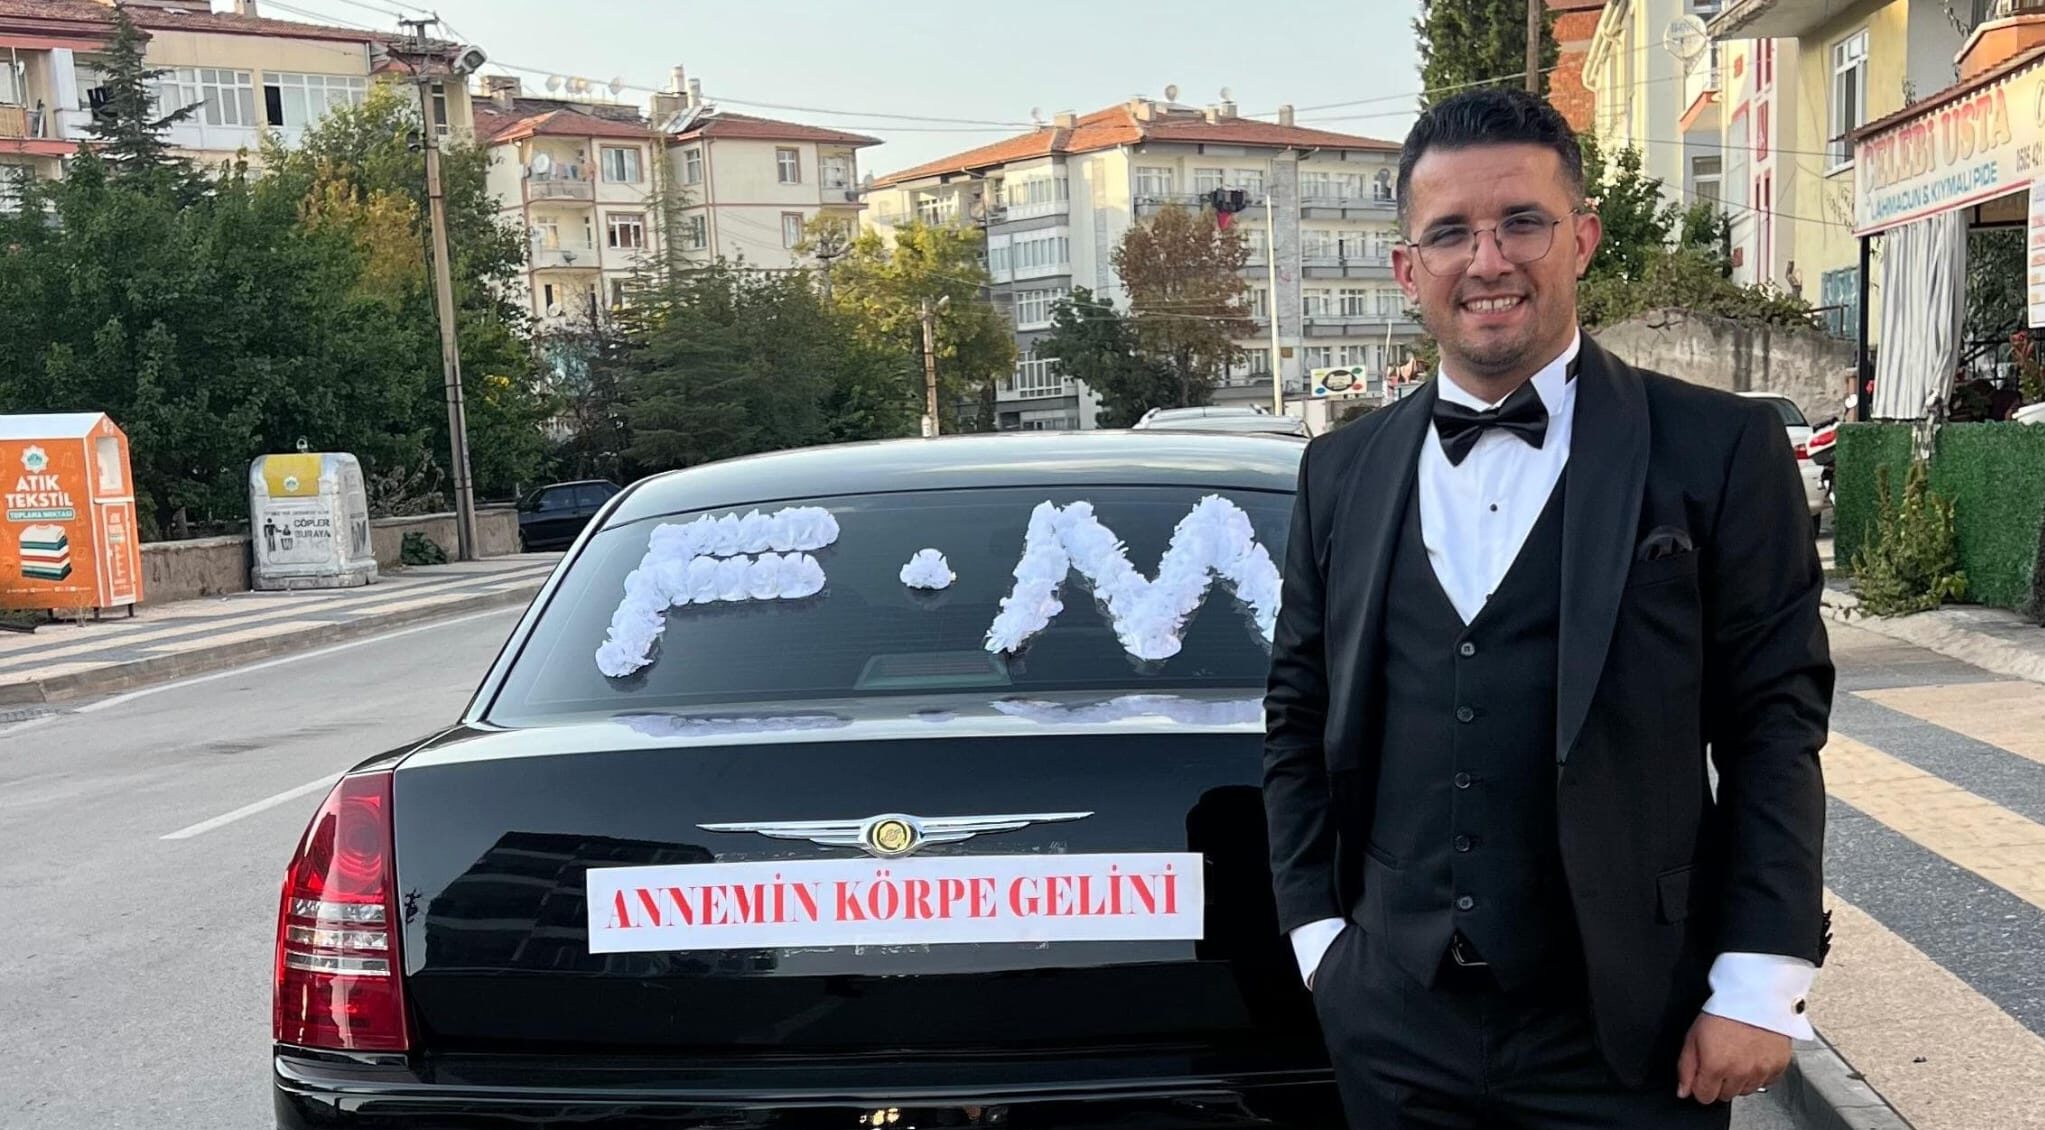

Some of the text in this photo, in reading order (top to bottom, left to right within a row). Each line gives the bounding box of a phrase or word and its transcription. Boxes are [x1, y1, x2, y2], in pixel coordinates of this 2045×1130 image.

[1941, 86, 2011, 166] USTA
[1871, 188, 1921, 220] LAHMACUN
[6, 490, 74, 508] TEKSTİL
[16, 475, 60, 492] ATIK
[985, 494, 1283, 660] M
[605, 863, 1179, 929] ANNEMİN KÖRPE GELİNİ
